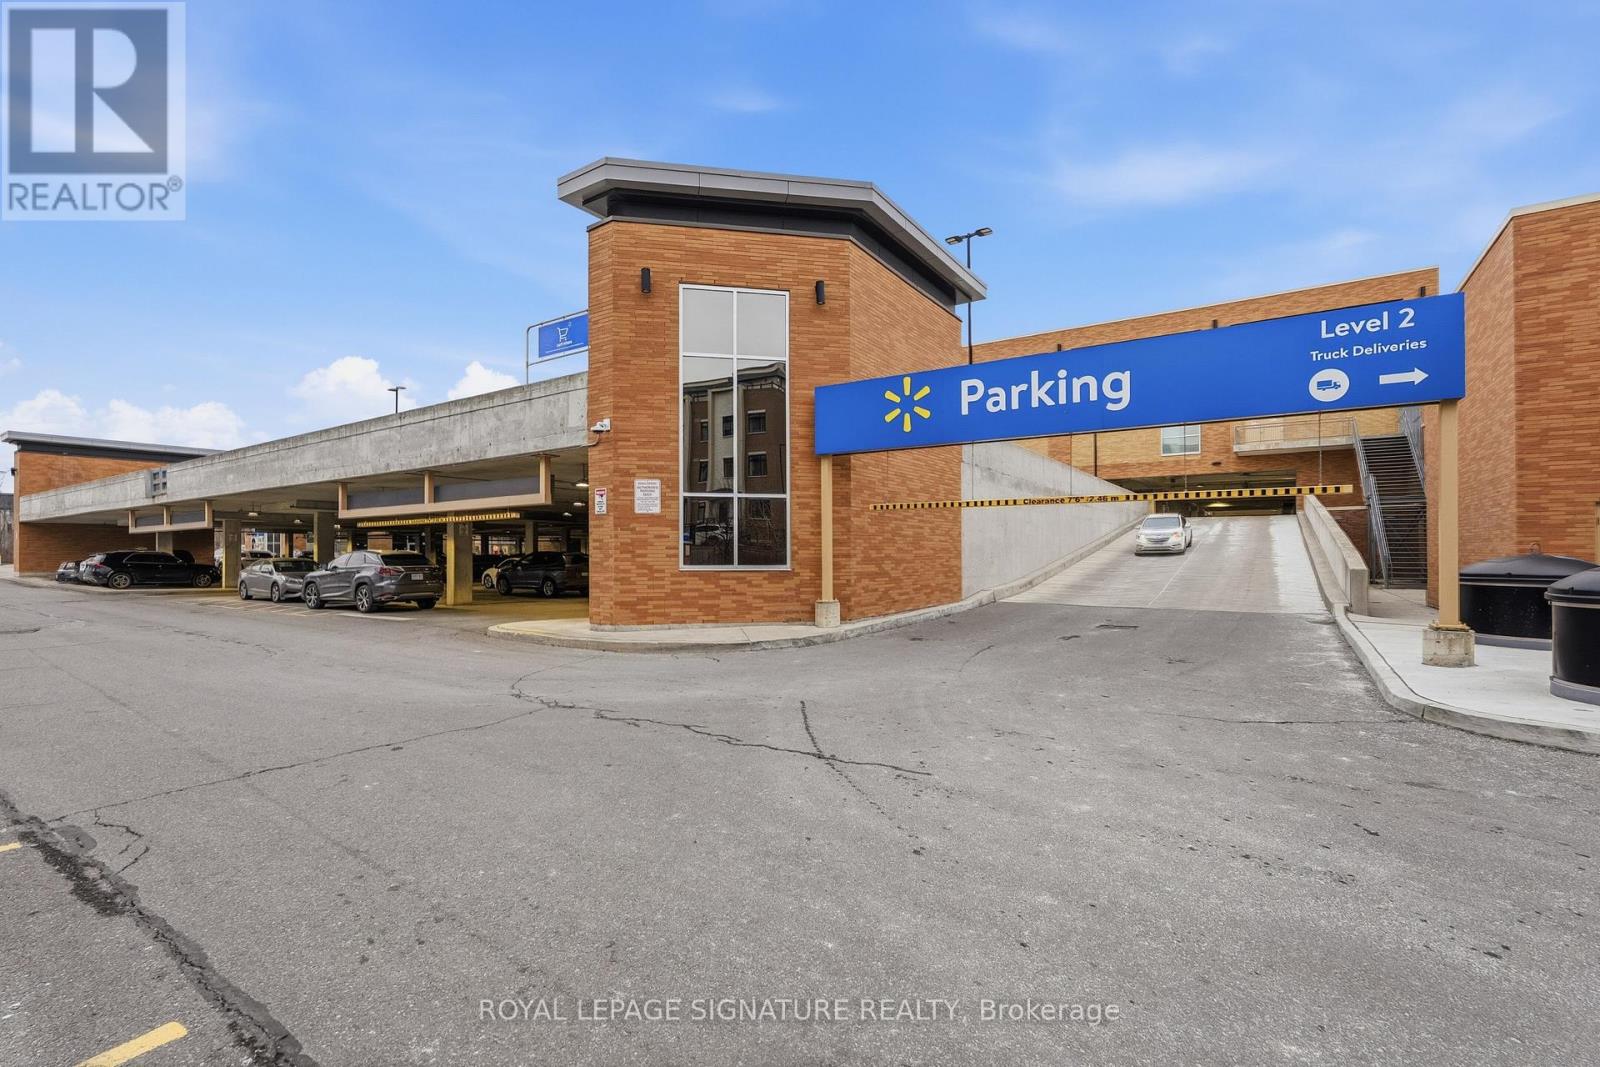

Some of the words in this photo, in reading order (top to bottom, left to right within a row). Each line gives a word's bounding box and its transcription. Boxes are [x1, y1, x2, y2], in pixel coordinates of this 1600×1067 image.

[1321, 311, 1388, 339] Level
[1398, 307, 1415, 329] 2
[1310, 347, 1349, 362] Truck
[1353, 339, 1428, 357] Deliveries
[960, 369, 1131, 416] Parking
[1023, 497, 1065, 505] Clearance
